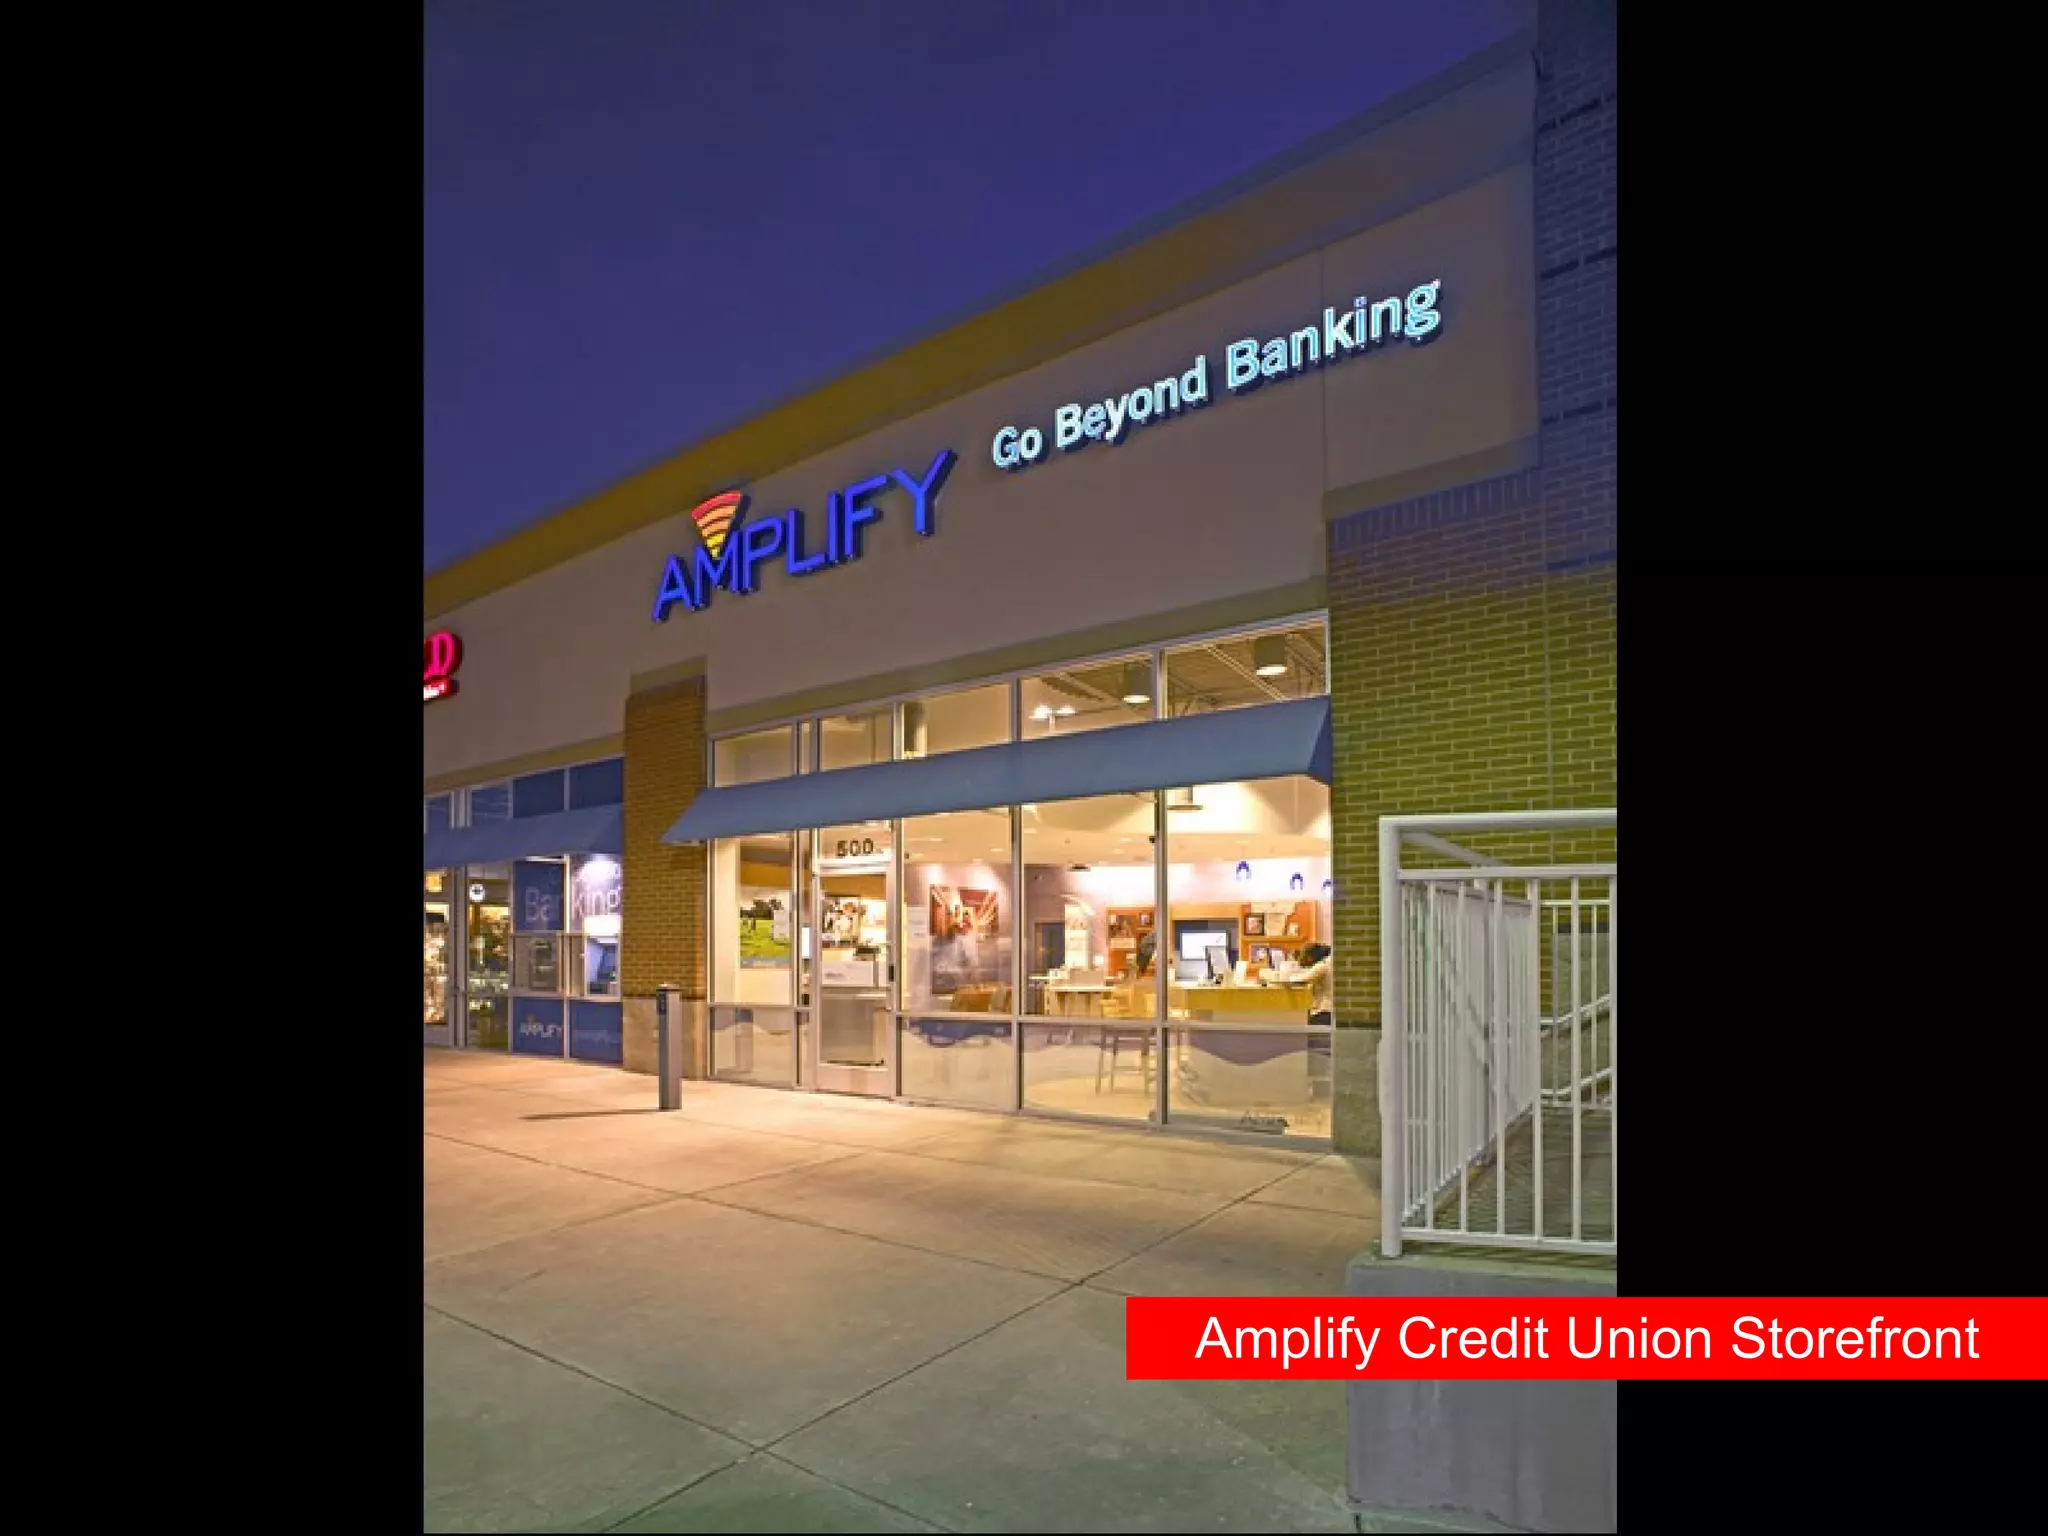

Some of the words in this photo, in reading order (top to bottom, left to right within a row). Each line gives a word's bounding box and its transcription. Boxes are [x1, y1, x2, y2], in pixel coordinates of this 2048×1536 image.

[992, 426, 1045, 470] Go
[1055, 354, 1209, 449] Beyond
[1226, 279, 1442, 391] Banking
[651, 448, 956, 623] AMPLIFY
[837, 837, 874, 858] 500
